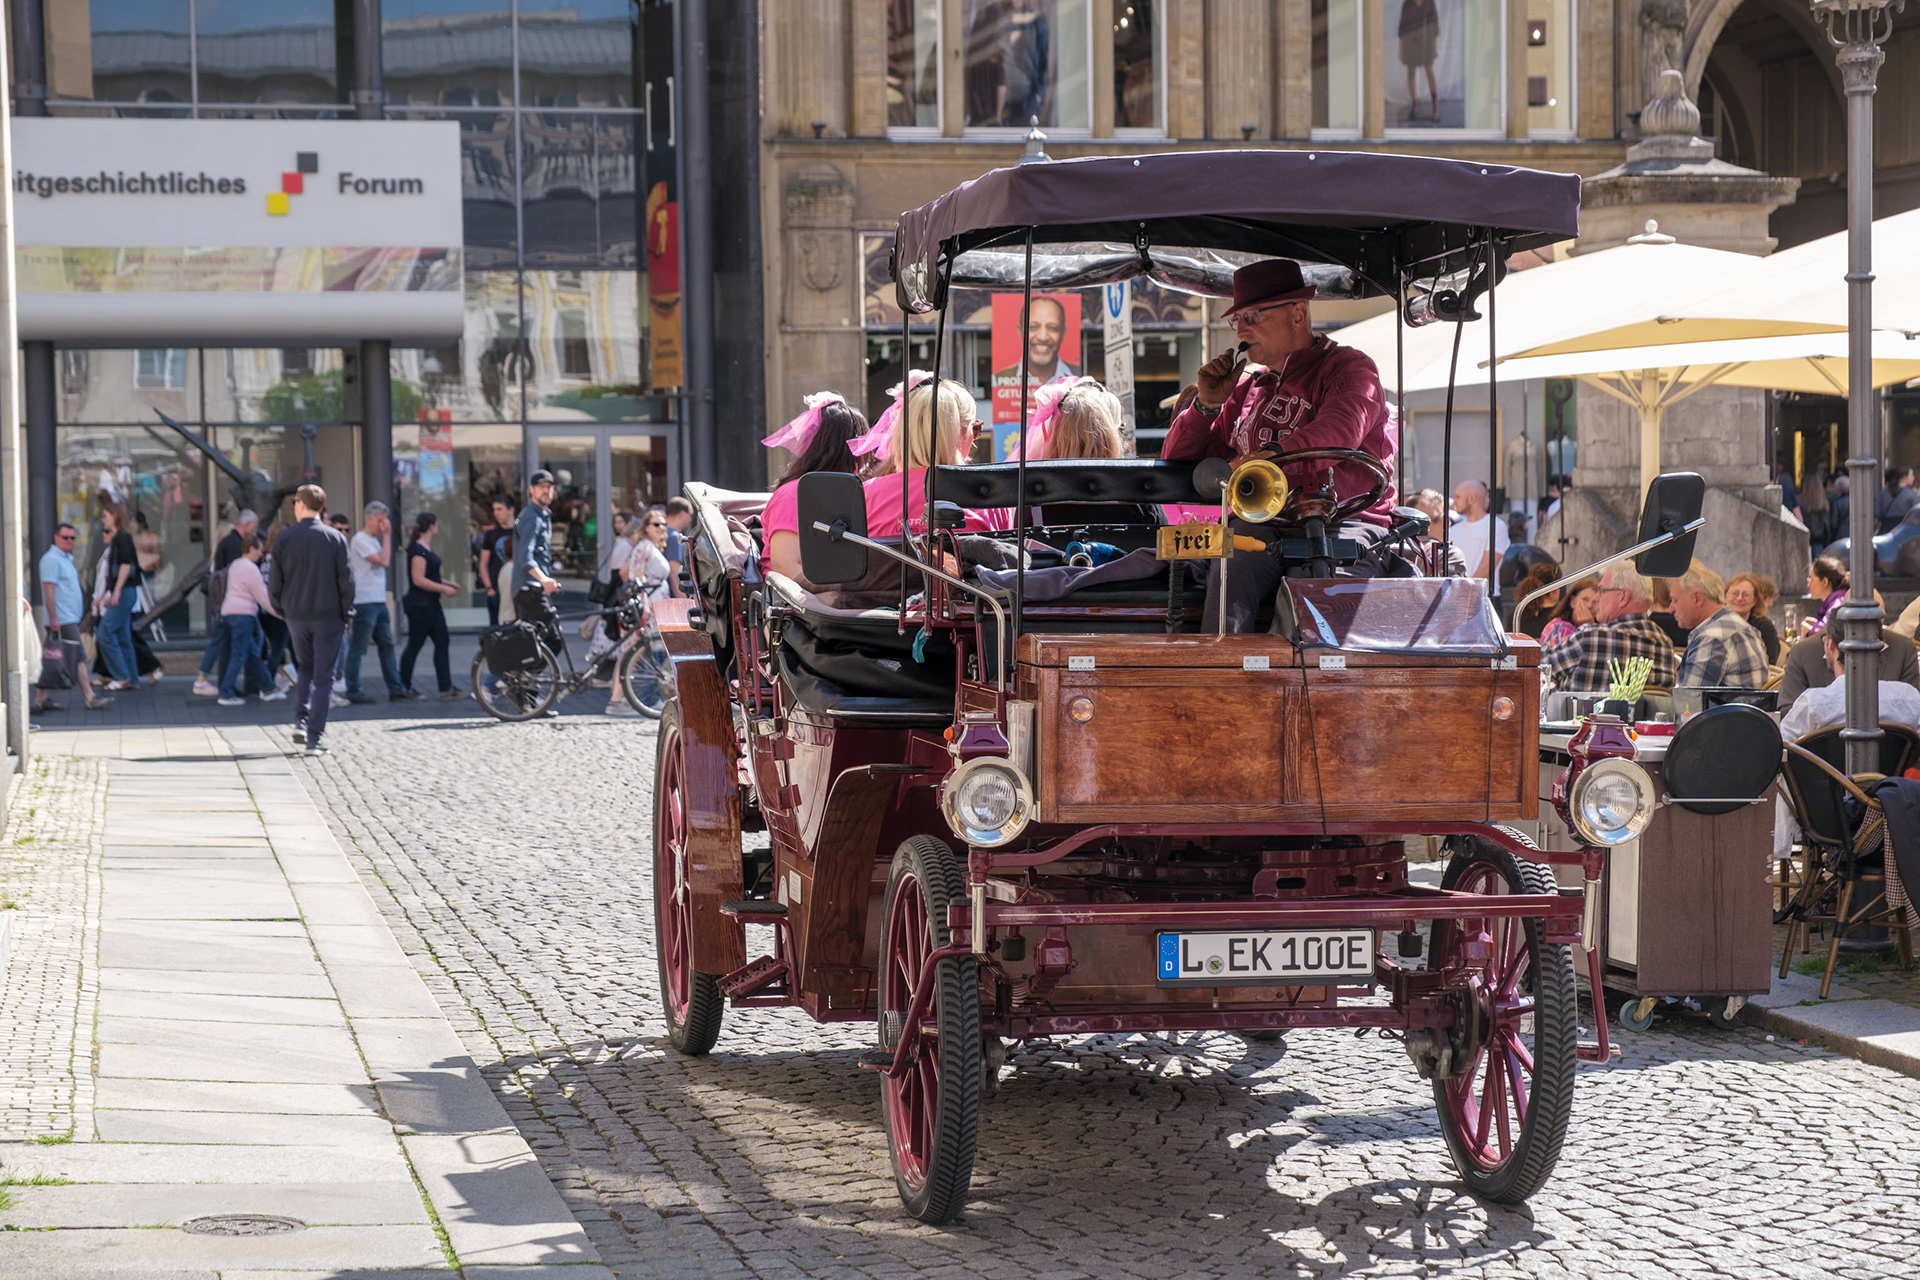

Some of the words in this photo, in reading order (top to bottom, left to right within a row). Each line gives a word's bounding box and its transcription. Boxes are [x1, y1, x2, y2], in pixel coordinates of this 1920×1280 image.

[12, 170, 248, 199] itgeschichtliches
[338, 171, 424, 195] Forum
[1110, 319, 1124, 340] ZONE
[1173, 528, 1211, 555] frei
[1165, 960, 1173, 971] D
[1182, 938, 1204, 972] L
[1228, 937, 1273, 972] EK
[1281, 935, 1368, 971] 100E
